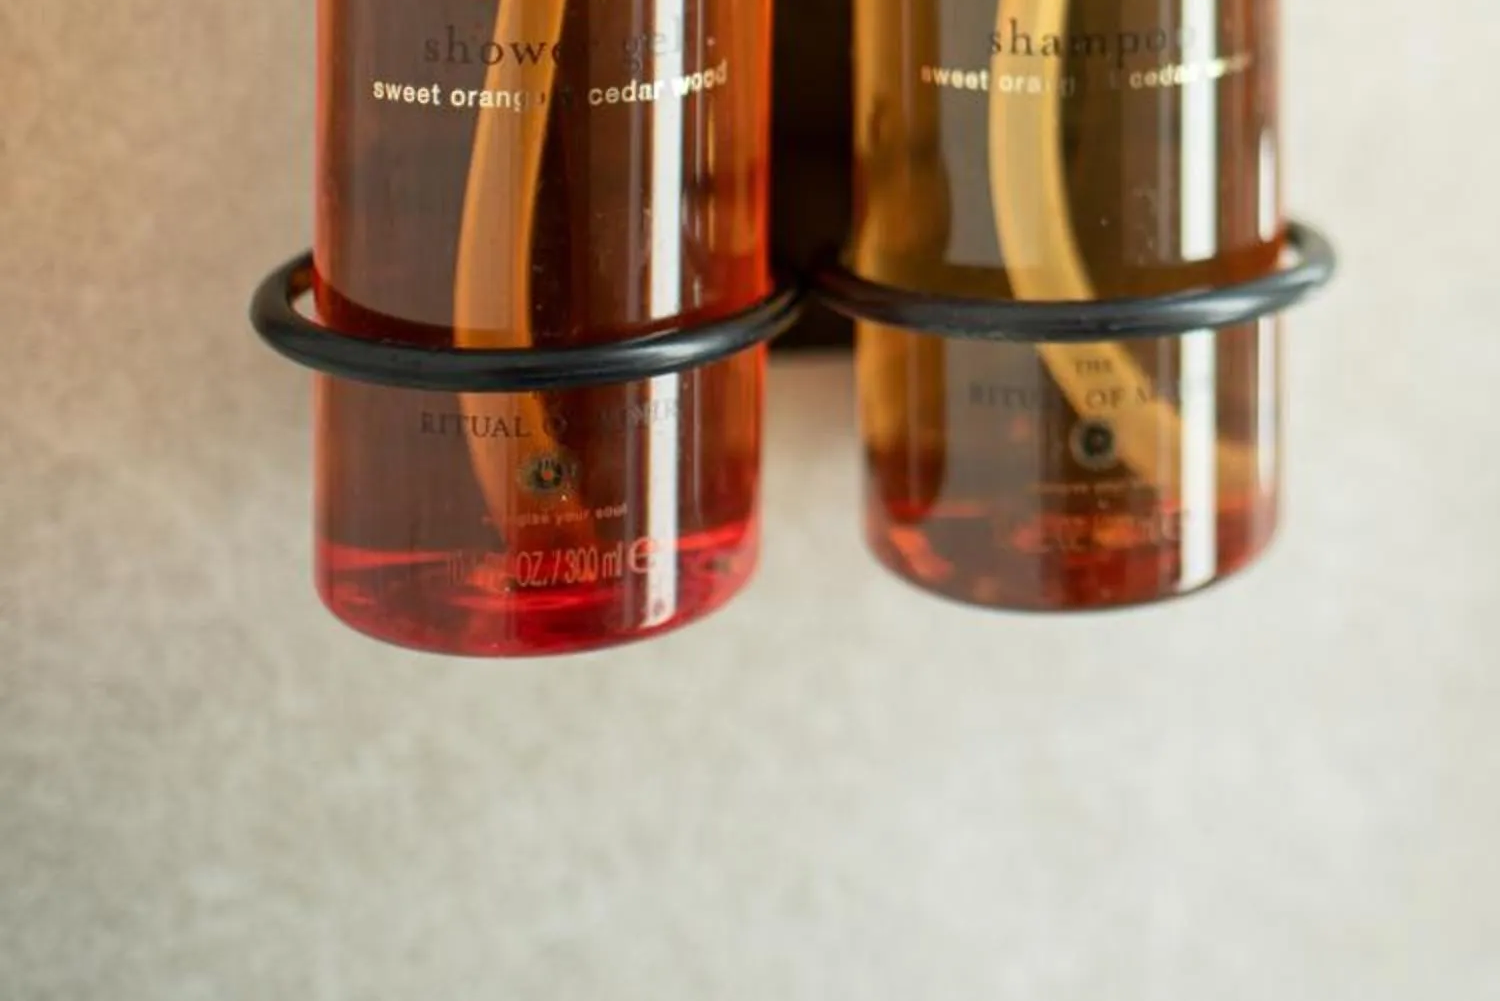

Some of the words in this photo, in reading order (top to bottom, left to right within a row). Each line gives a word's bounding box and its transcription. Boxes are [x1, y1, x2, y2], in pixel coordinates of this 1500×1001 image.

[423, 23, 600, 65] show
[373, 79, 441, 105] sweet
[450, 90, 546, 112] orang
[588, 78, 663, 105] cedar
[665, 59, 729, 96] wood
[919, 64, 989, 91] sweet
[419, 410, 532, 438] RITUAL
[562, 546, 599, 584] 300
[602, 540, 624, 579] ml
